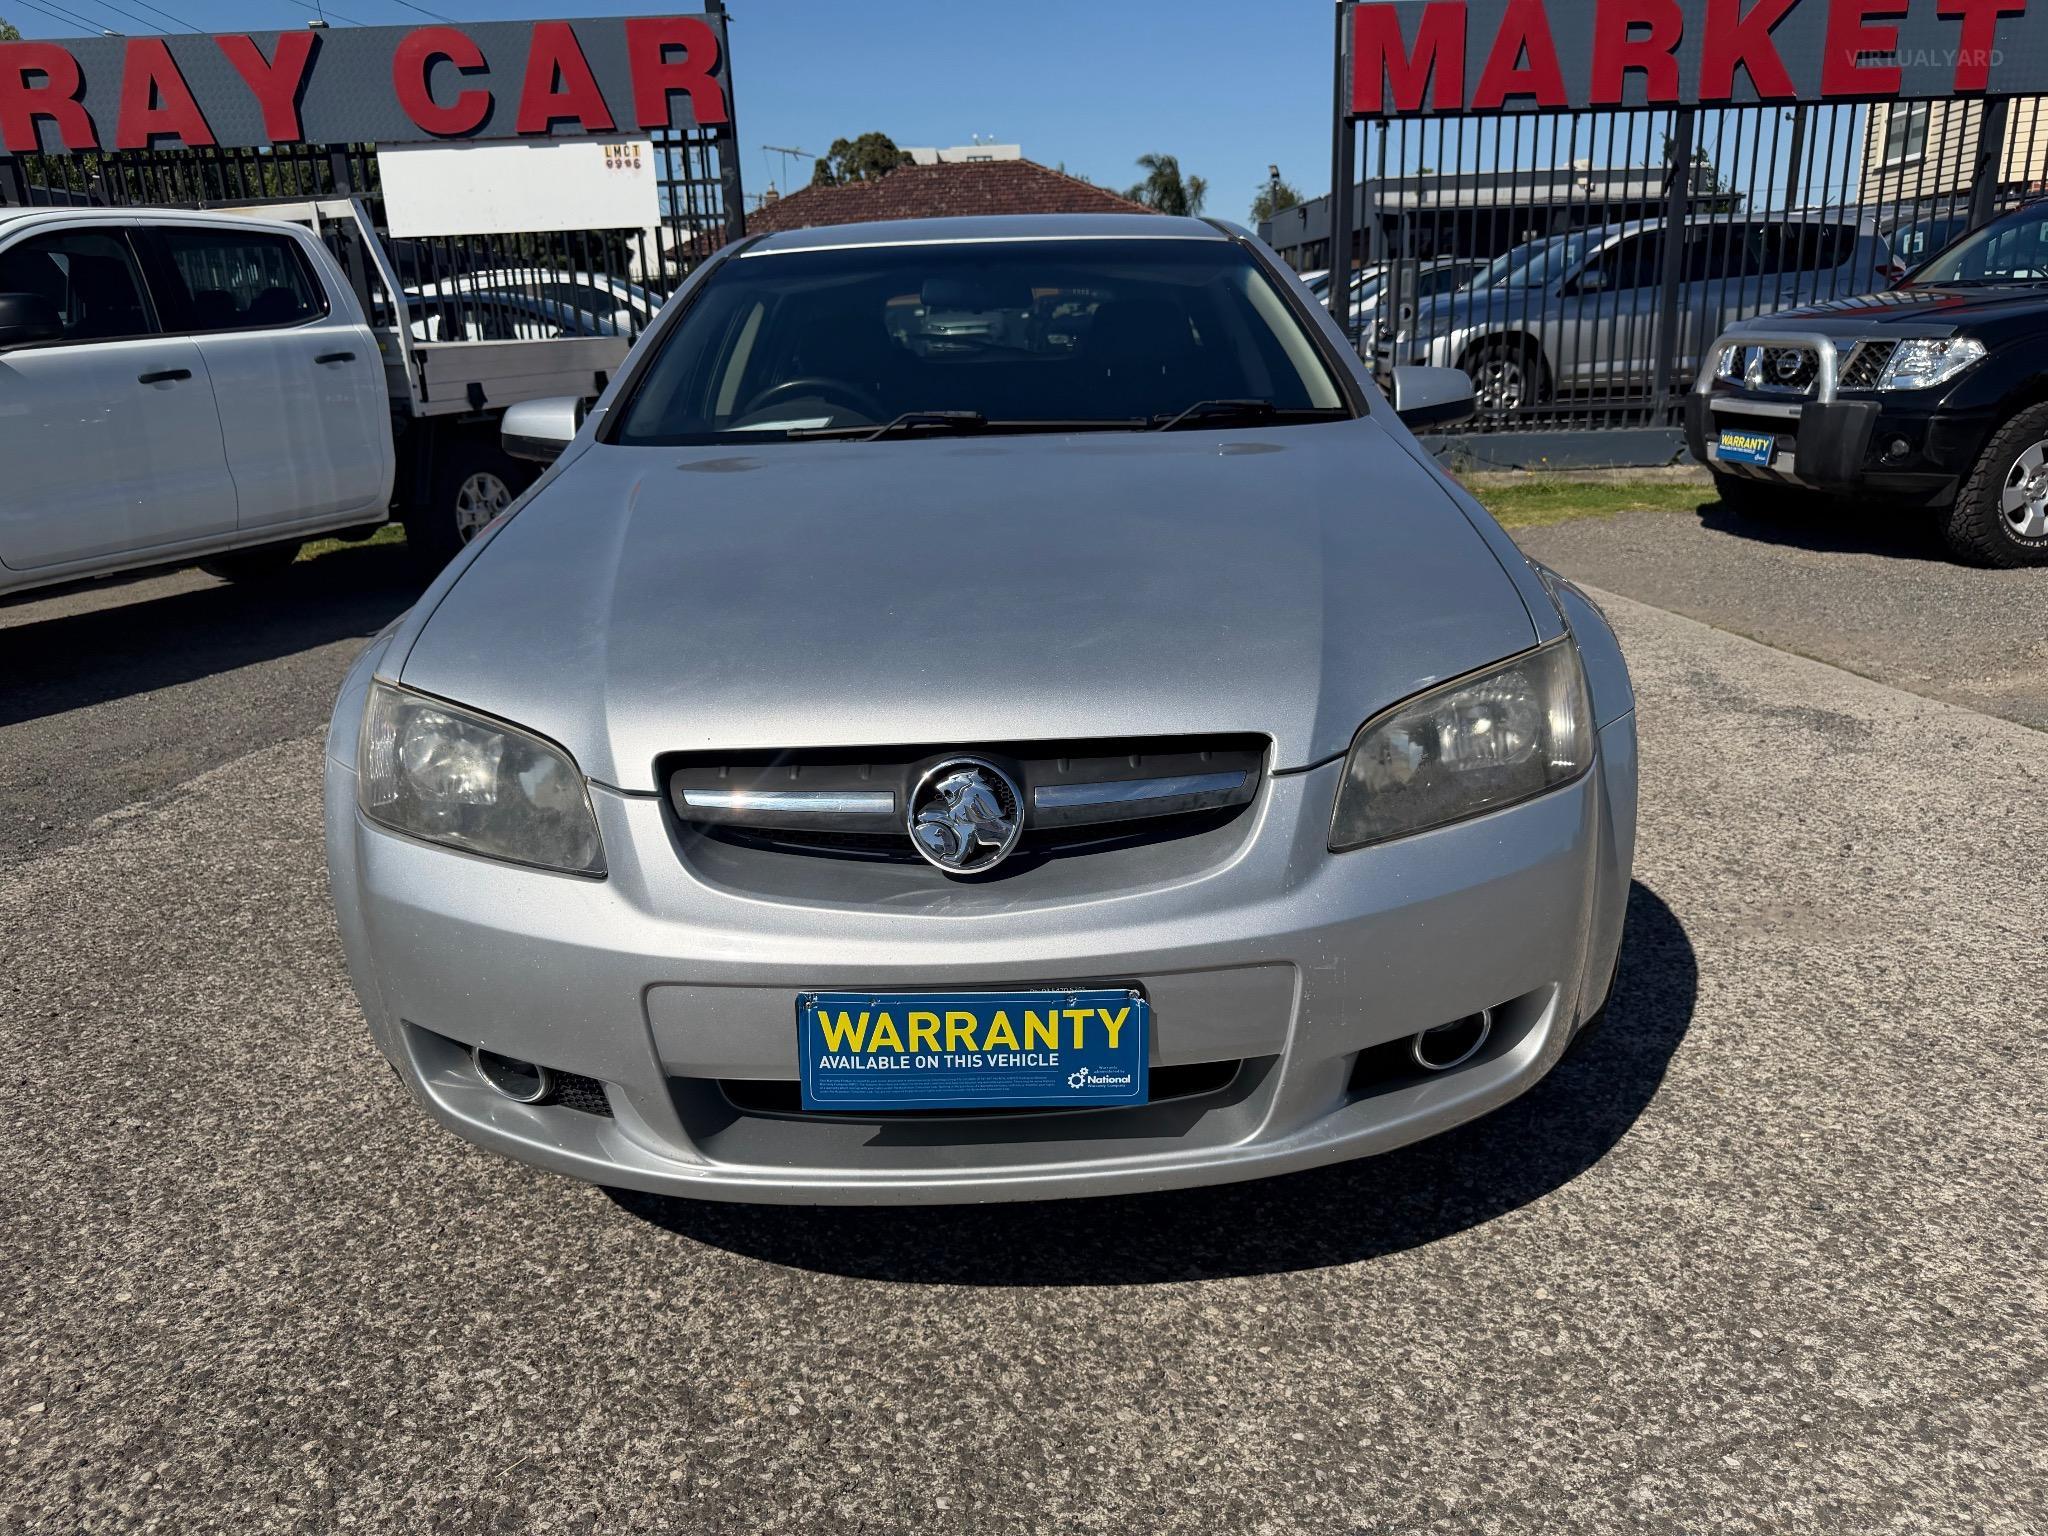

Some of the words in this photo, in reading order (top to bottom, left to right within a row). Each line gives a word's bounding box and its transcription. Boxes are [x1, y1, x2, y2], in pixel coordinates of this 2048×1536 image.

[1352, 0, 2026, 113] MARKET
[0, 32, 317, 152] RAY
[393, 18, 728, 135] CAR
[605, 145, 639, 157] LMCT
[1721, 434, 1769, 451] WARRANTY
[817, 1007, 1131, 1053] WARRANTY
[819, 1055, 910, 1070] AVAILABLE
[915, 1055, 940, 1069] ON
[944, 1054, 982, 1068] THIS
[990, 1053, 1059, 1067] VEHICLE
[1087, 1074, 1131, 1084] National
